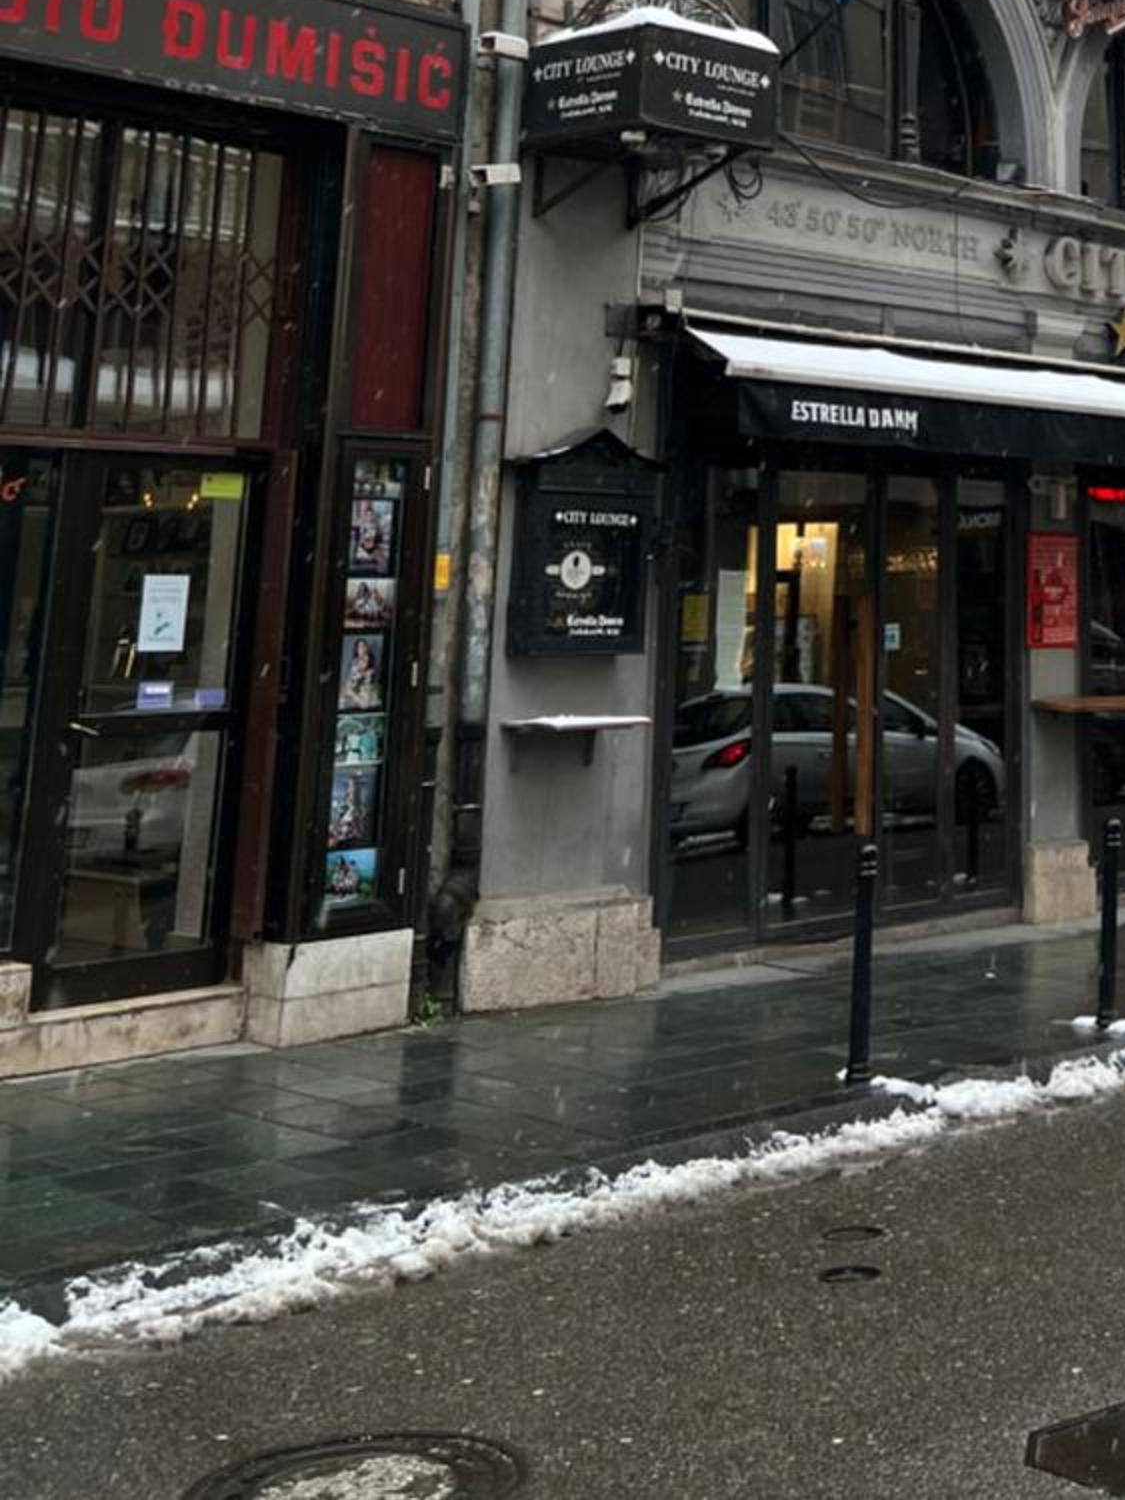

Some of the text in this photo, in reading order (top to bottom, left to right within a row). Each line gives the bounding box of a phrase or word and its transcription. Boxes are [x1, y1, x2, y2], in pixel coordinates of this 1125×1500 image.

[544, 60, 573, 80] CITY
[575, 49, 625, 75] LOUNGE
[666, 51, 760, 89] CITY LOUNGE
[791, 399, 865, 428] ESTRELLA
